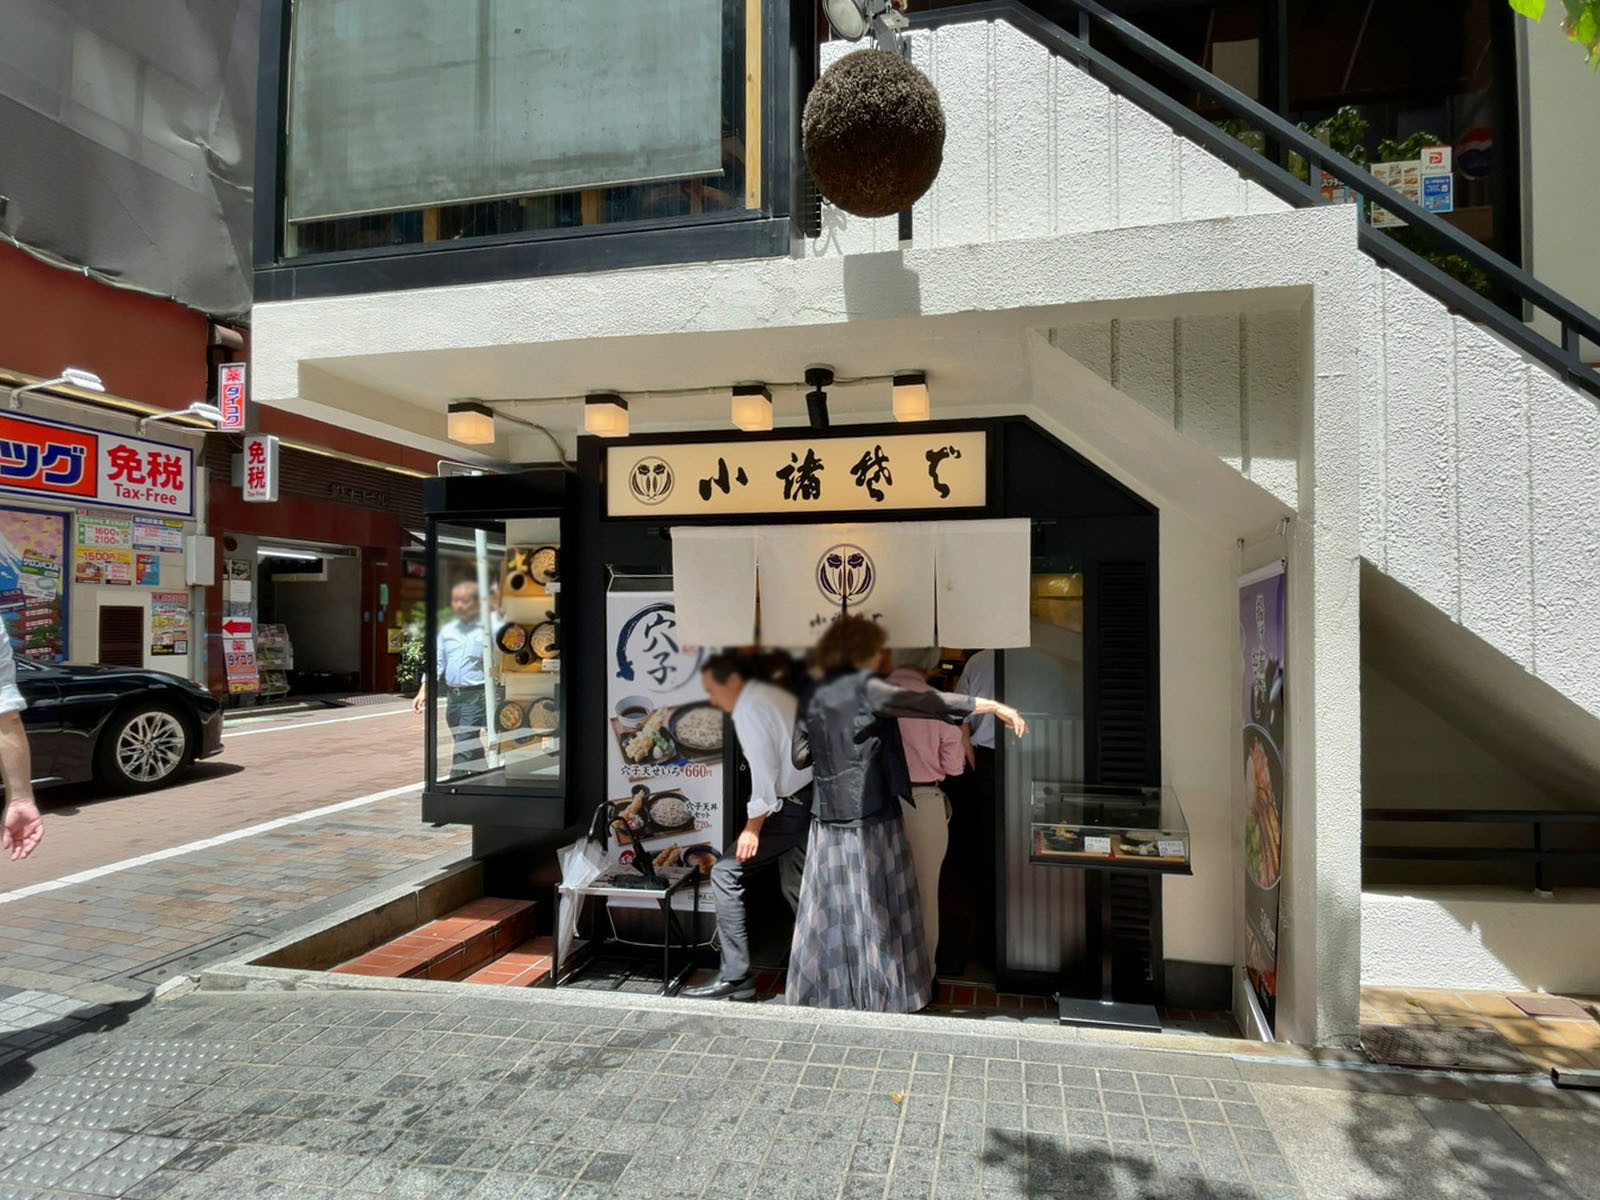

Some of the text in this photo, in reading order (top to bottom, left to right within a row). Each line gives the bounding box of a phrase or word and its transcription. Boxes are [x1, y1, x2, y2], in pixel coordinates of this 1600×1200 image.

[107, 444, 184, 491] 免税
[248, 441, 266, 489] 免税
[114, 483, 177, 505] Tax-Free
[642, 612, 680, 686] 穴子
[621, 765, 681, 777] 穴子天せいろ
[686, 801, 718, 811] 穴子天丼
[694, 811, 711, 819] セット
